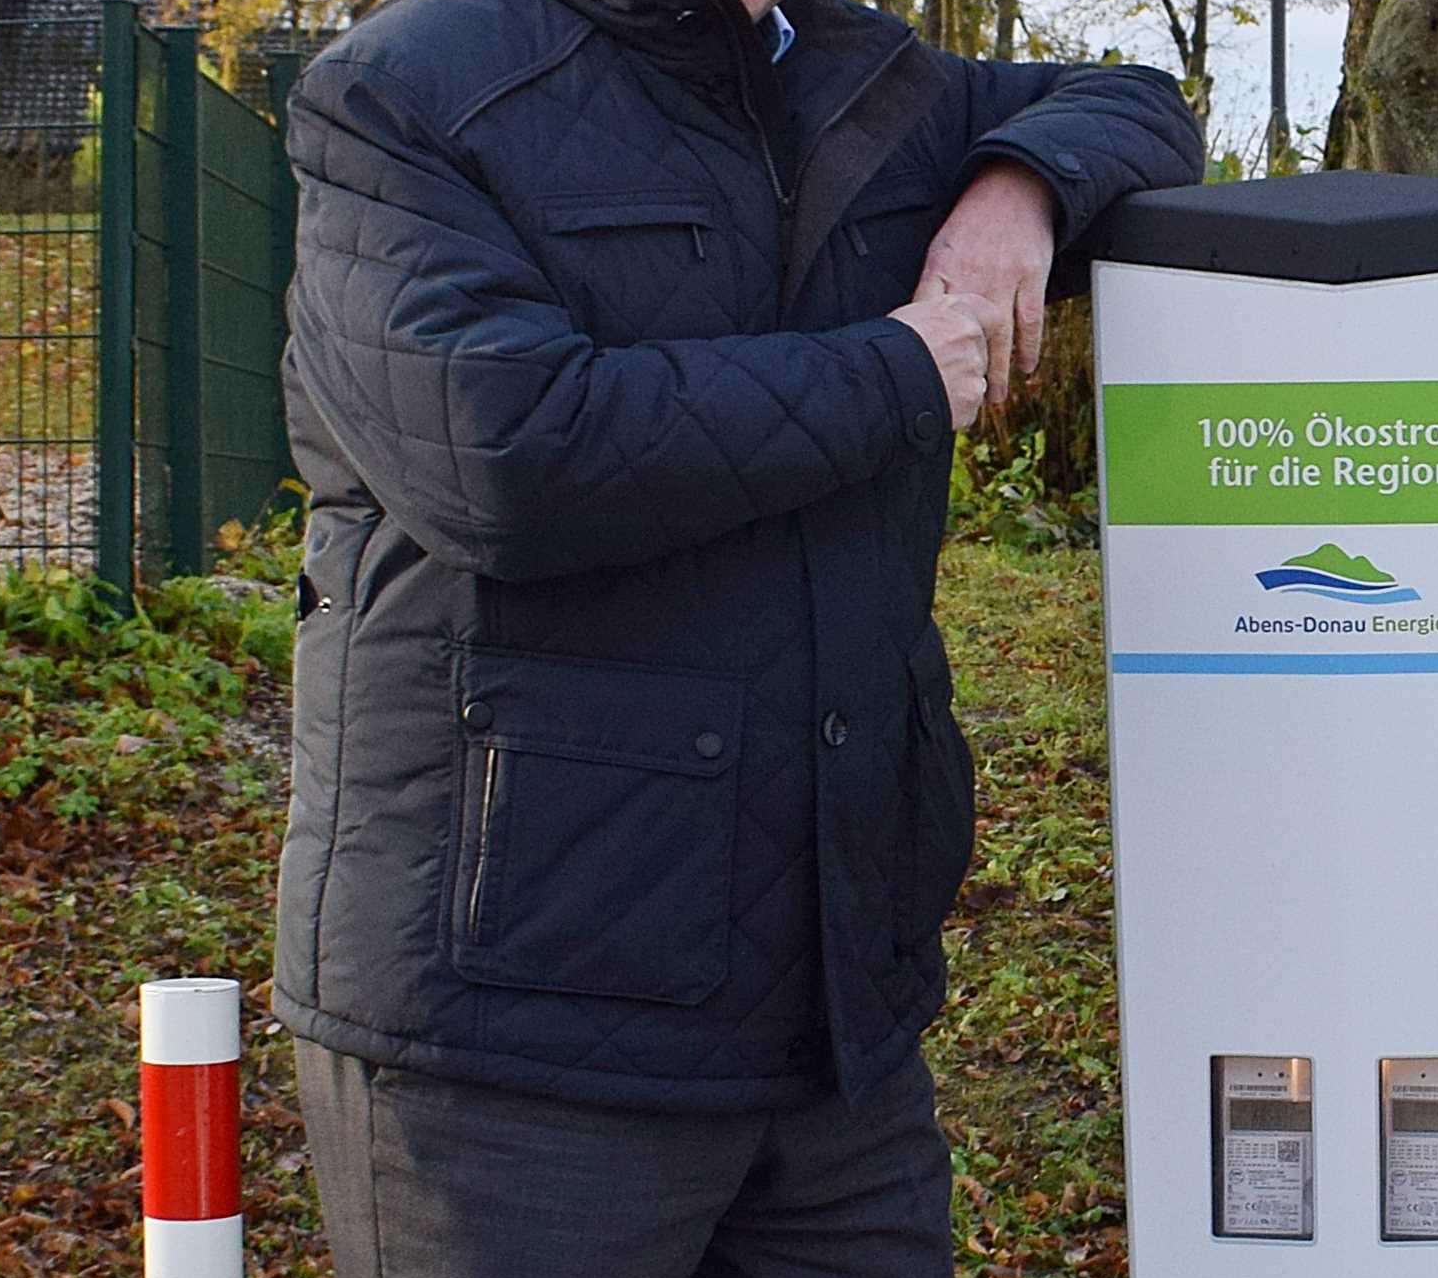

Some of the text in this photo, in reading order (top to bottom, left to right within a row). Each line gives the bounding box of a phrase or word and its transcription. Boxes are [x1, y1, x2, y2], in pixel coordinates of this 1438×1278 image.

[1197, 418, 1295, 448] 100%
[1208, 457, 1259, 487] für
[1268, 456, 1322, 487] die
[1234, 615, 1366, 634] Abens-Donau
